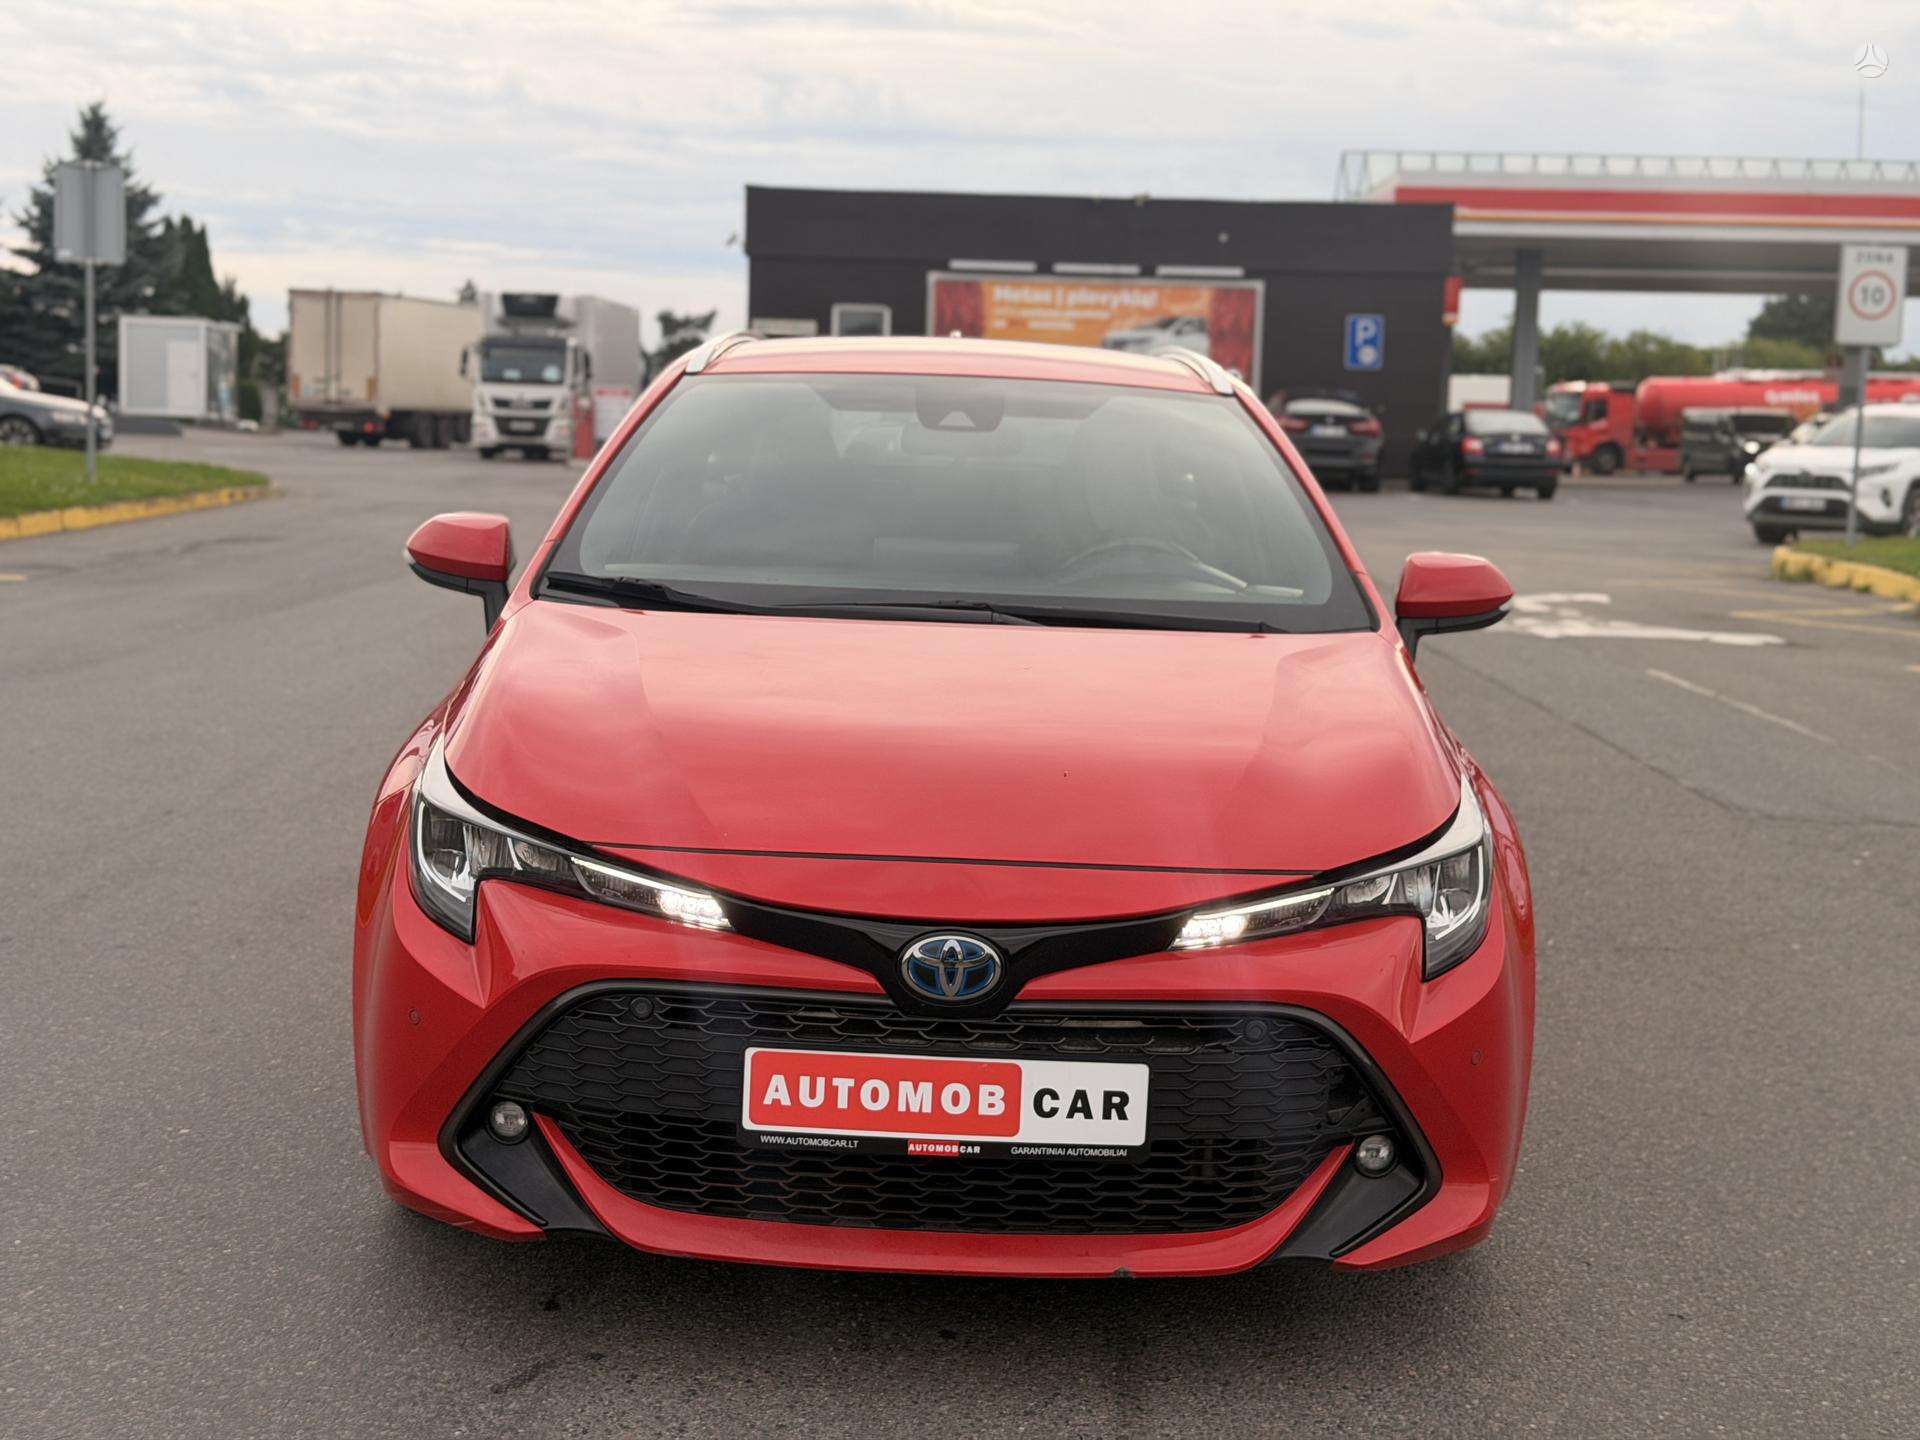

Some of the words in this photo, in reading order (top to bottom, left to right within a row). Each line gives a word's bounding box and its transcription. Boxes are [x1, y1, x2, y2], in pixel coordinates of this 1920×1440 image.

[1861, 286, 1885, 307] 10
[1356, 319, 1376, 347] P
[762, 1074, 1006, 1116] AUTOMOB
[1032, 1087, 1130, 1121] CAR
[760, 1135, 859, 1148] WWW.AUTOMOBCAR.LT
[1010, 1146, 1066, 1155] GARANTINIAI
[1067, 1147, 1128, 1156] AUTOMOBILIAI
